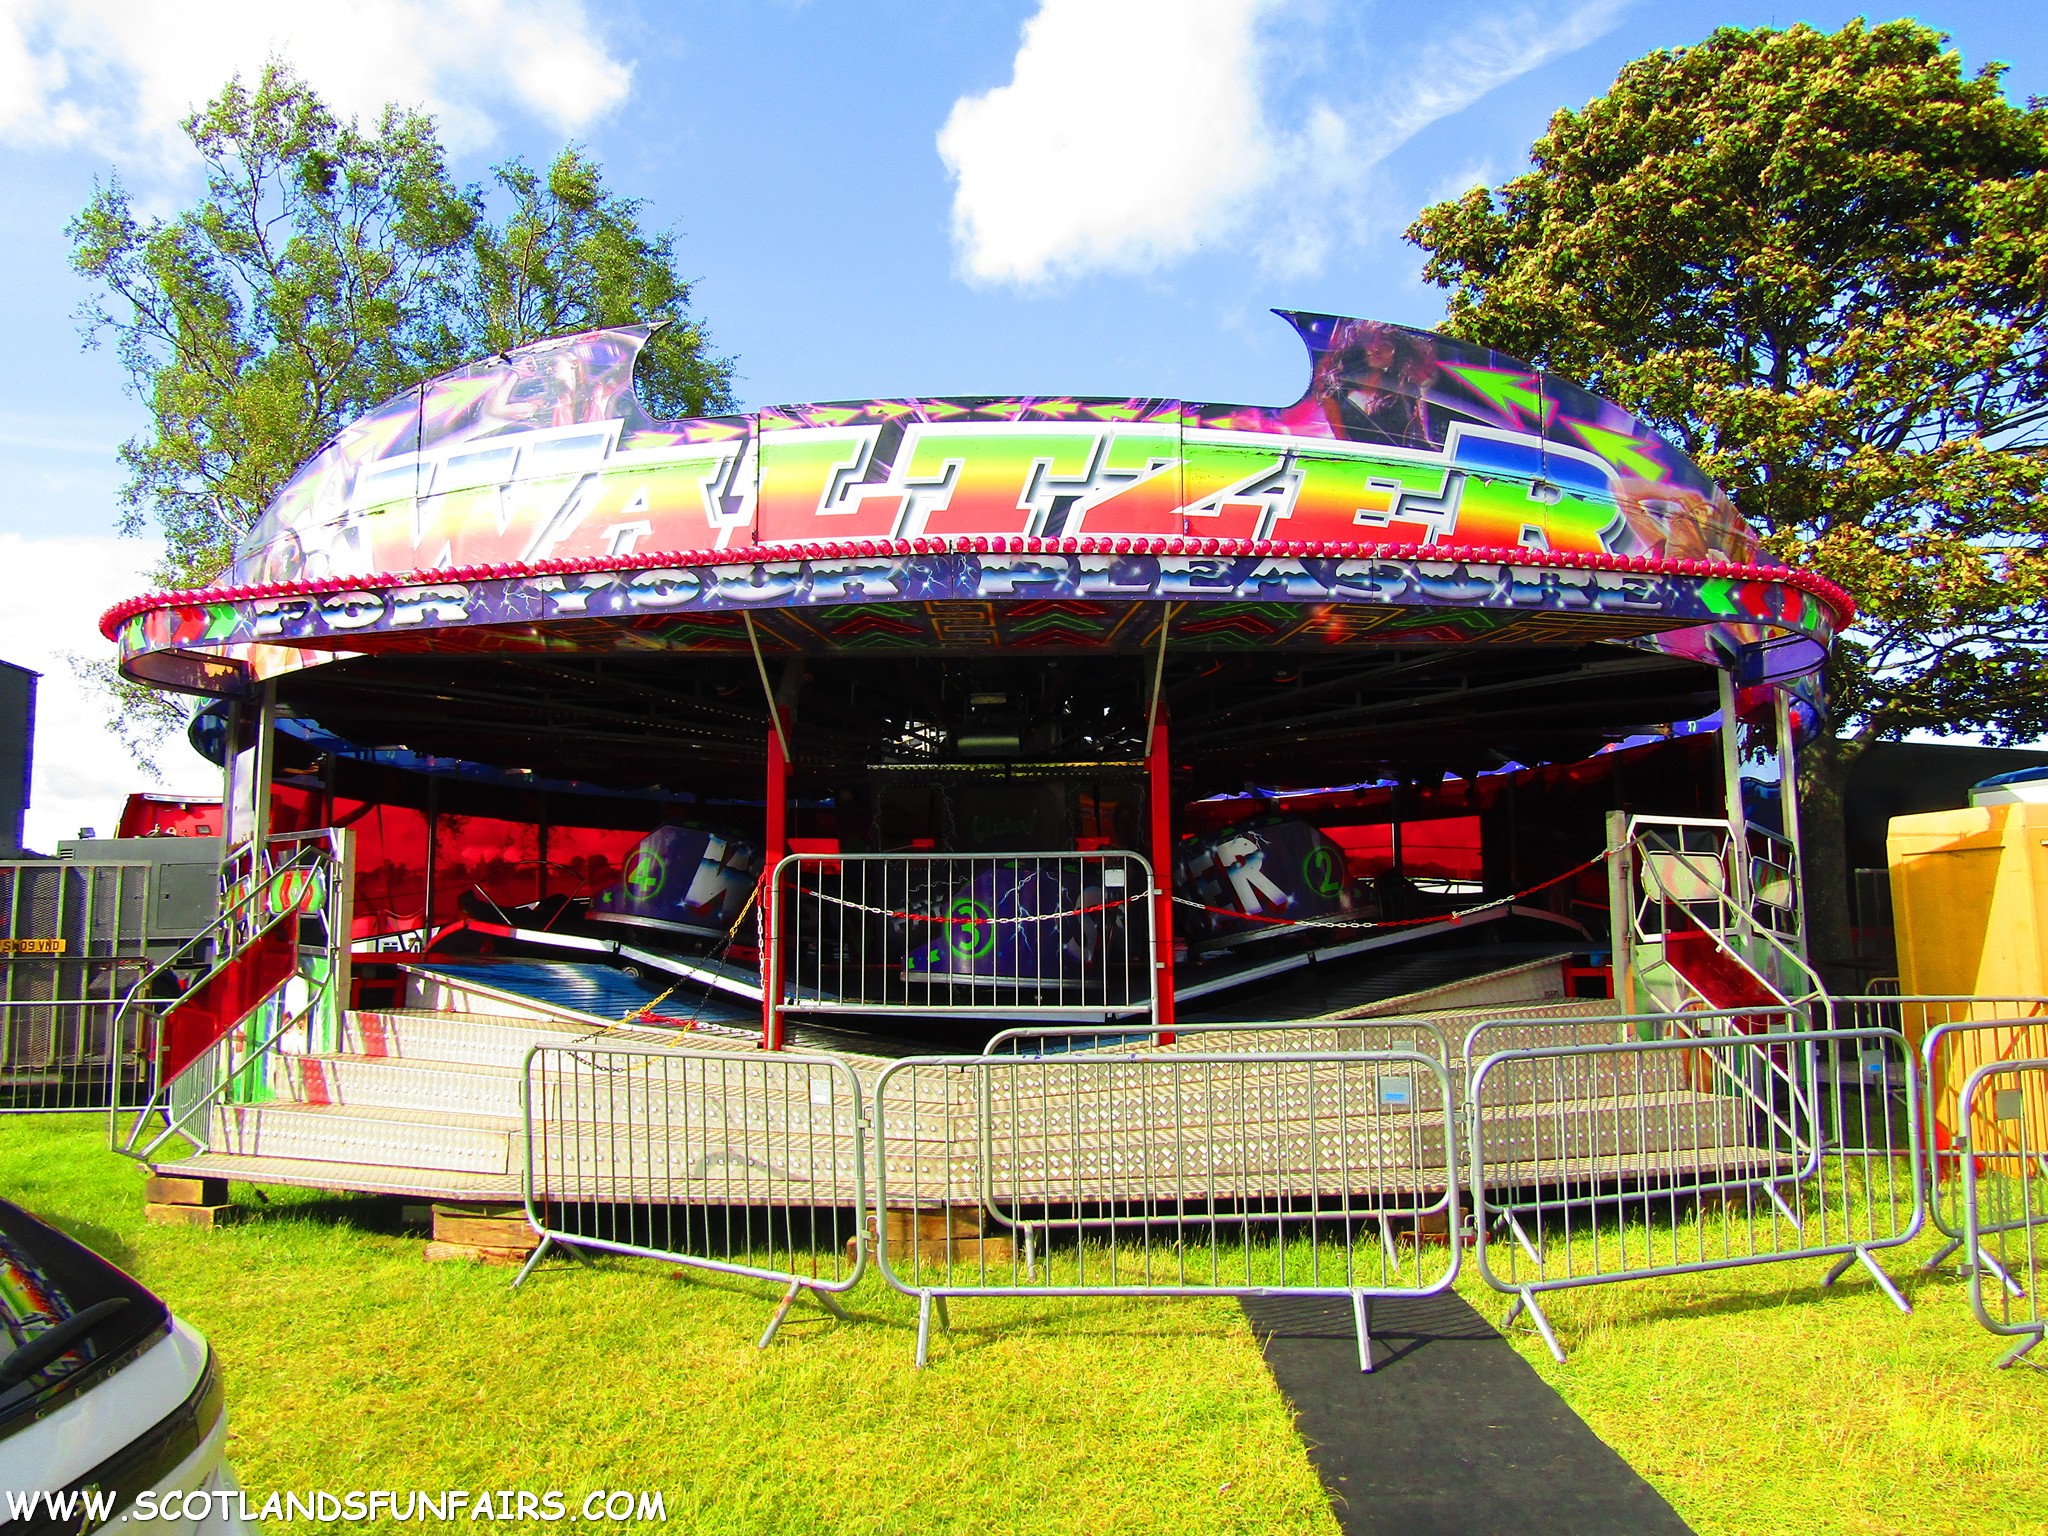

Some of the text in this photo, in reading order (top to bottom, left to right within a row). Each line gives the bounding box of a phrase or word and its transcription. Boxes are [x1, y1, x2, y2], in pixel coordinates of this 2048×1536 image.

[336, 416, 1630, 574] WALTZER
[254, 552, 1662, 634] FOR YOUR PLEASURE
[628, 858, 656, 892] 4
[1315, 852, 1339, 894] 2
[958, 904, 981, 951] 3
